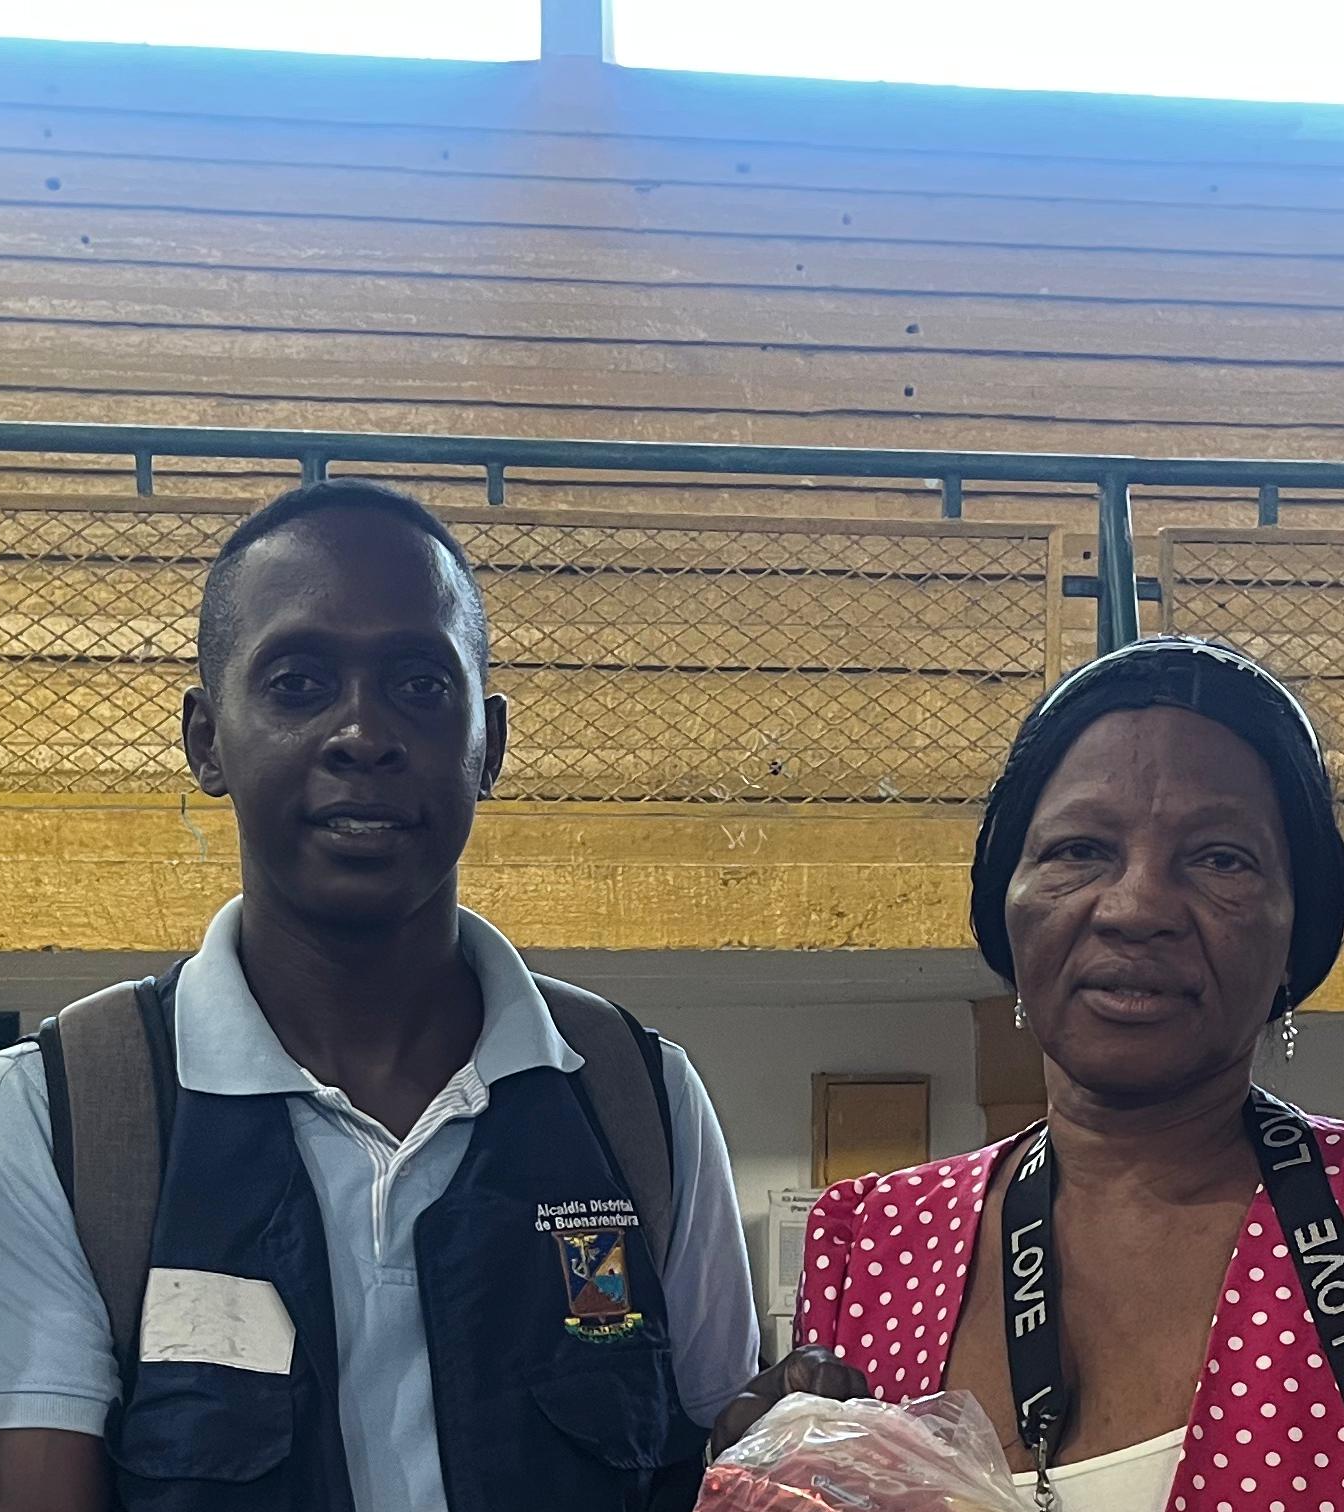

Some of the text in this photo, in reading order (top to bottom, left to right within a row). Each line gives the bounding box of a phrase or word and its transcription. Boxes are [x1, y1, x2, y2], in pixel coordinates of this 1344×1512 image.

[590, 1198, 634, 1213] Distrital
[535, 1219, 551, 1232] de
[1010, 1219, 1047, 1338] LOVE
